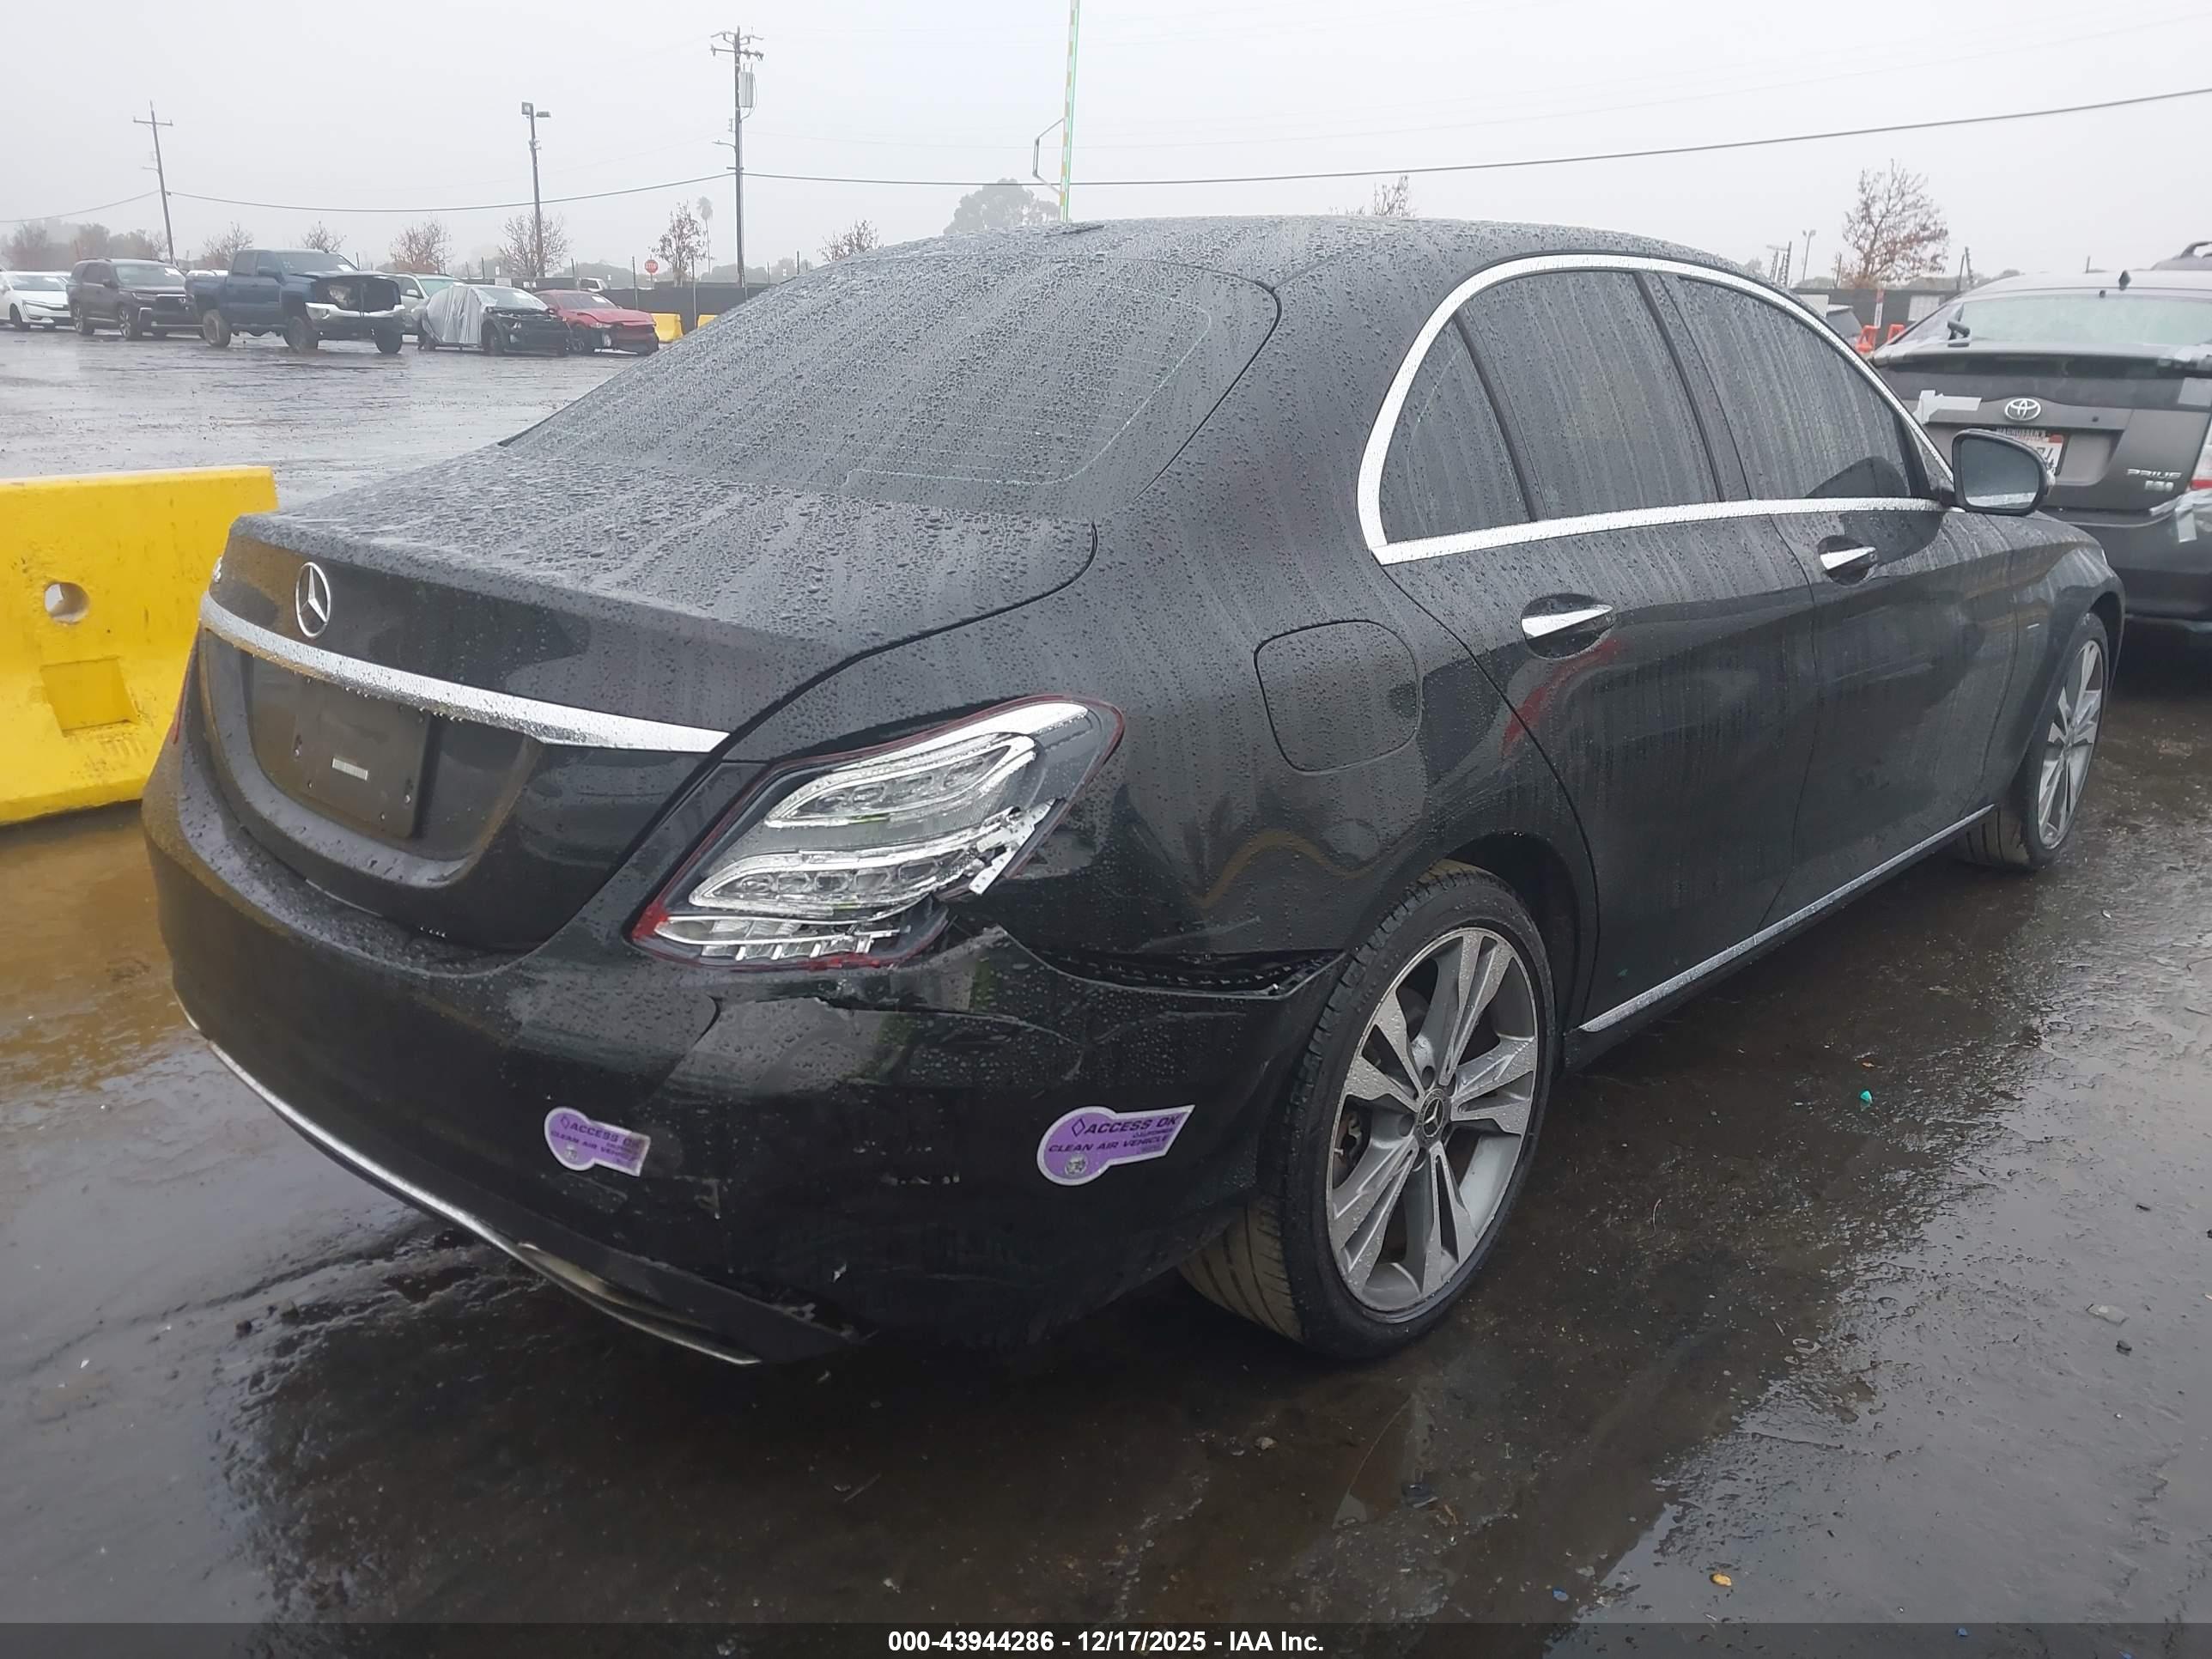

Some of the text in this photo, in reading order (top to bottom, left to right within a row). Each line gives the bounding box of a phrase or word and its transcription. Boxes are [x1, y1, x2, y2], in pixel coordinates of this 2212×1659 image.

[2127, 469, 2182, 479] PRIUS
[570, 1122, 619, 1142] ACCESS
[1084, 1115, 1180, 1134] ACCESS OK
[550, 1129, 580, 1143] CLEAN
[582, 1140, 598, 1150] AIR
[1048, 1143, 1094, 1152] CLEAN
[1123, 1135, 1168, 1147] VEHICLE
